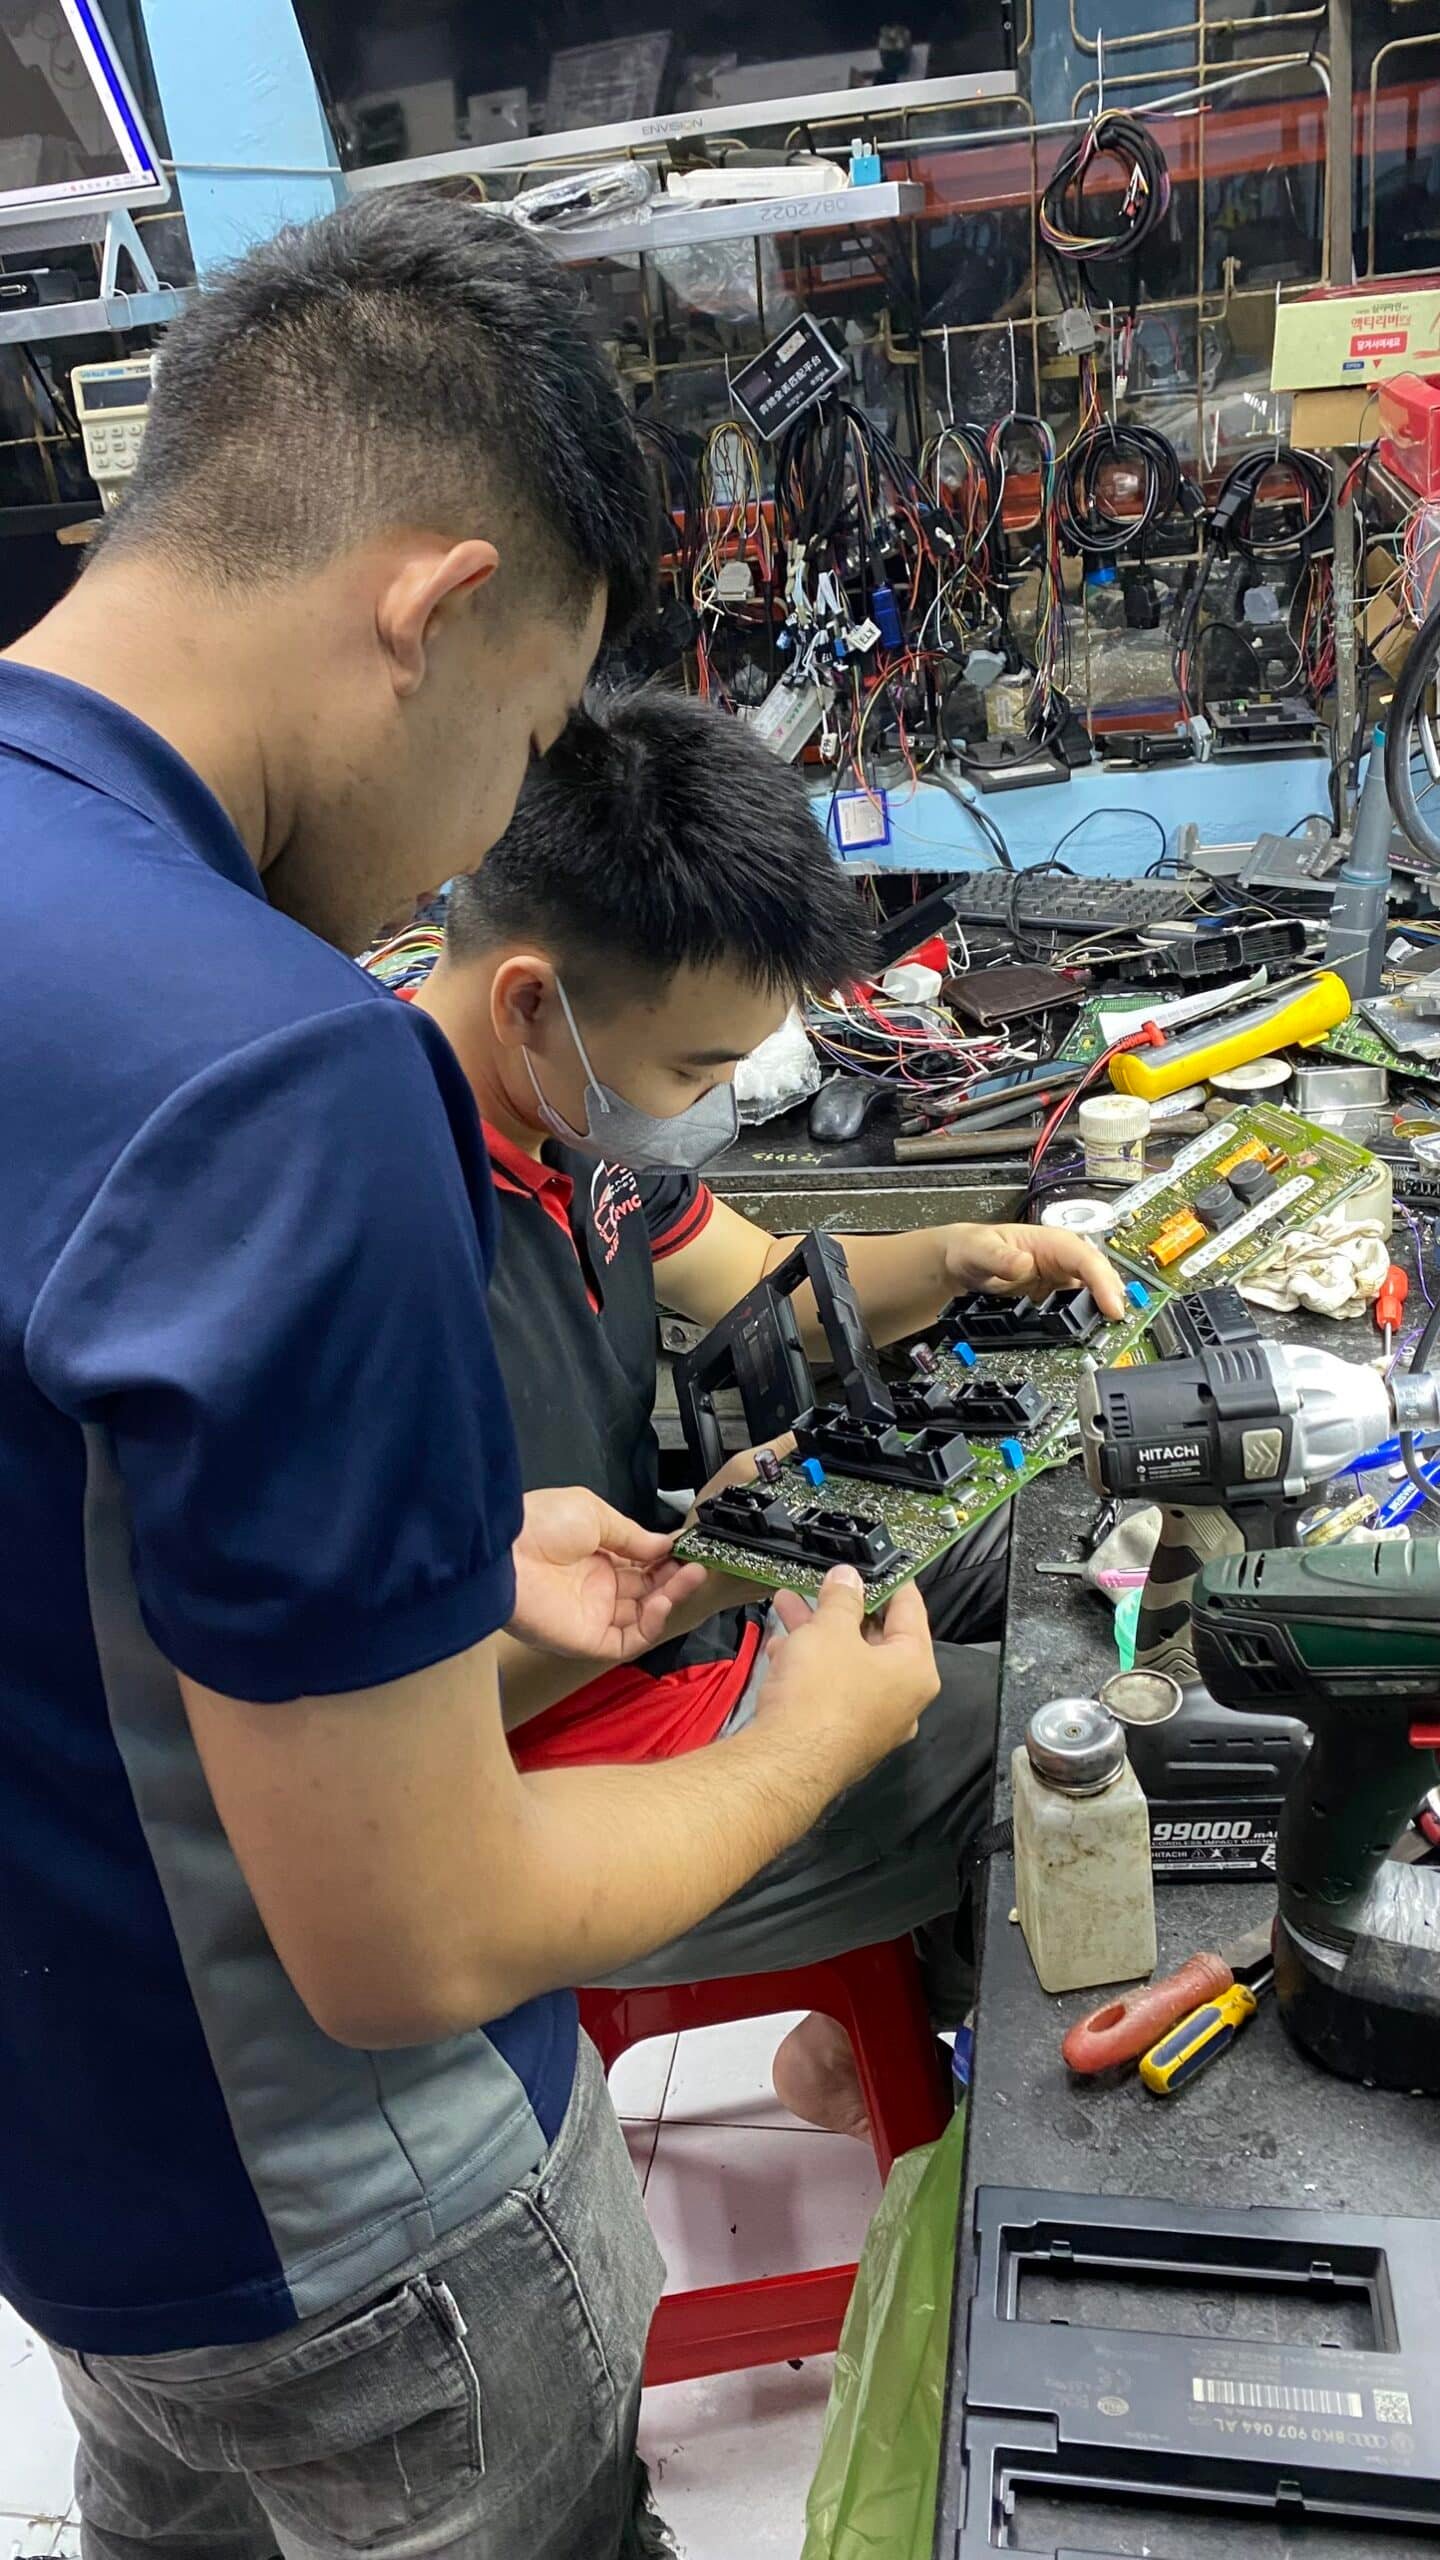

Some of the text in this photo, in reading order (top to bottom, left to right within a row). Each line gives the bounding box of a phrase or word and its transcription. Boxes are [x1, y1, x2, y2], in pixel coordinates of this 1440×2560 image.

[641, 117, 703, 136] ENVISION
[1138, 1444, 1200, 1462] HITACHI
[1152, 1821, 1252, 1841] 99000
[1151, 1850, 1188, 1859] HITACHI
[1213, 2418, 1345, 2444] 8K0 907 064 AL
